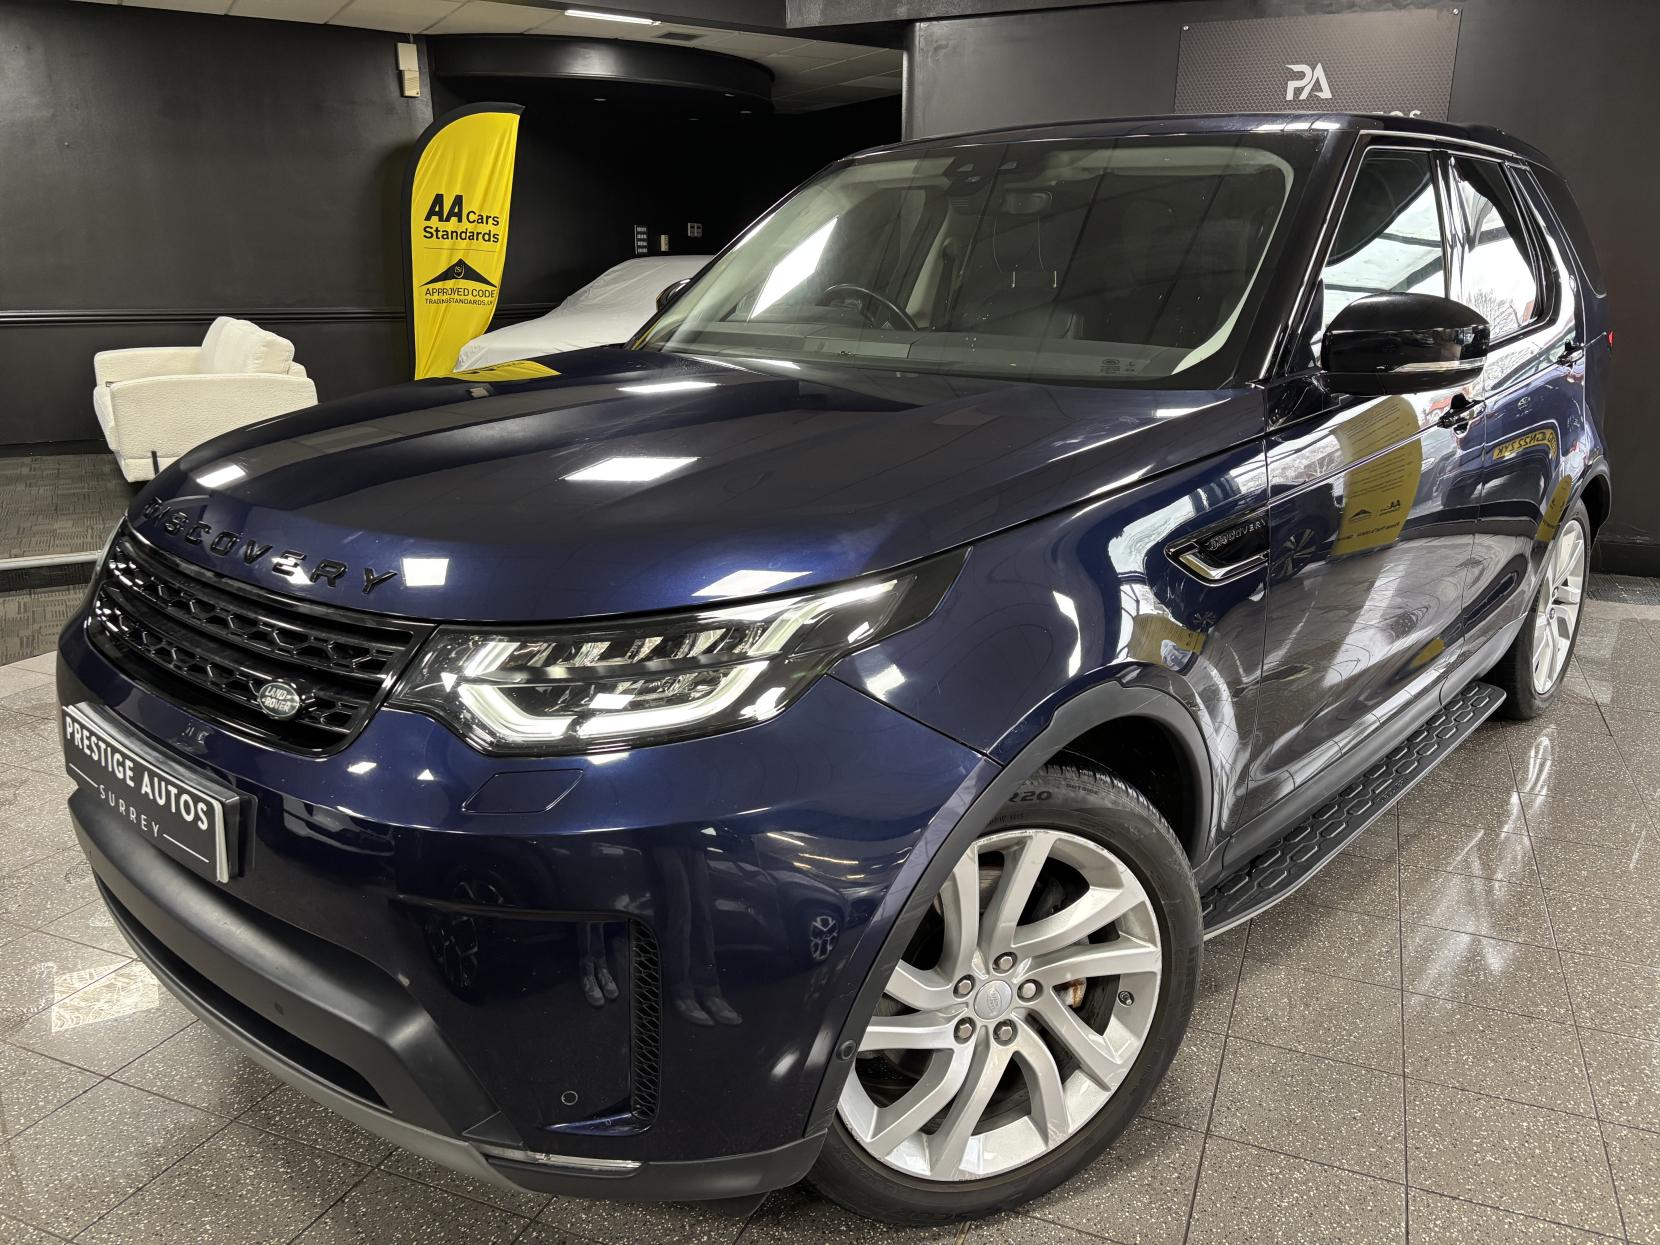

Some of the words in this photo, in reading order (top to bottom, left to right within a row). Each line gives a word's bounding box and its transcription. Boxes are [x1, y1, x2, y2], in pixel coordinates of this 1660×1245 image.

[1285, 62, 1333, 100] PA
[424, 193, 463, 223] AA
[466, 210, 500, 226] Cars
[423, 225, 500, 243] Standards
[425, 287, 470, 297] APPROVED
[471, 288, 496, 298] CODE
[264, 696, 290, 712] ROVER
[265, 686, 288, 700] LAND
[65, 715, 135, 788] PRESTIGE
[141, 770, 209, 831] AUTOS
[99, 784, 159, 837] SURREY
